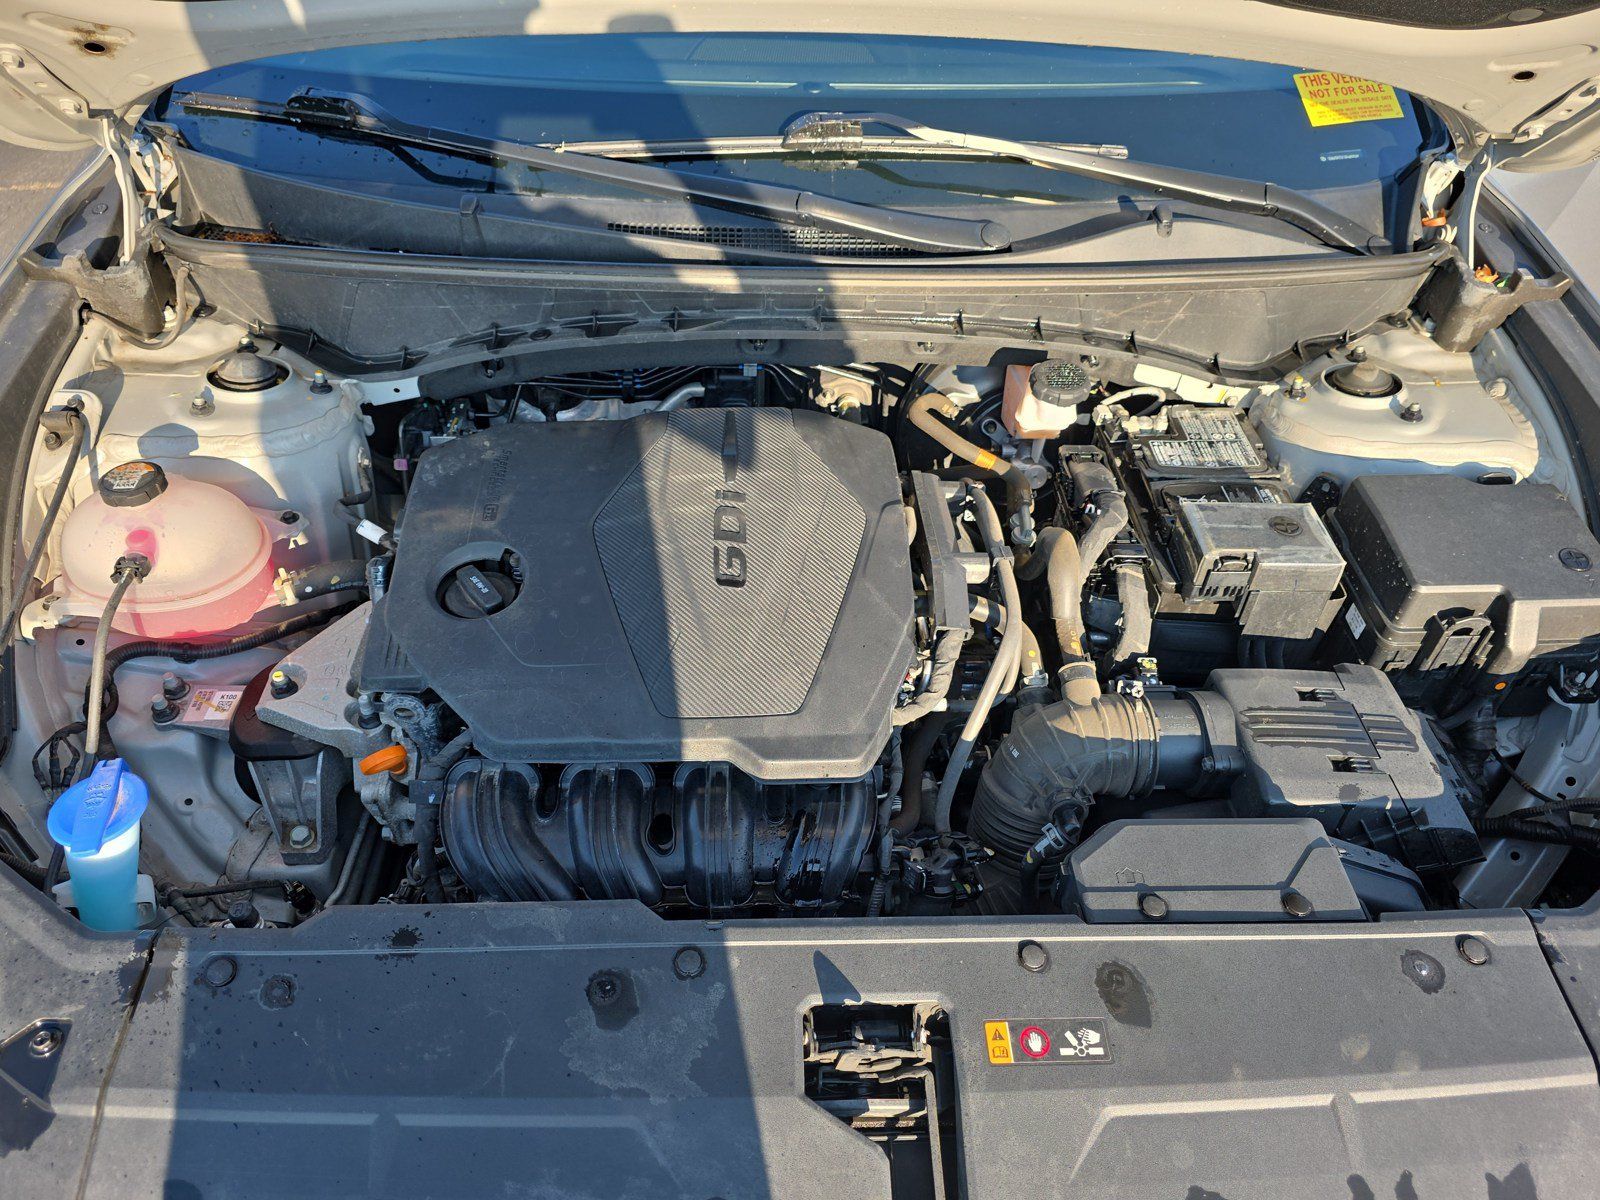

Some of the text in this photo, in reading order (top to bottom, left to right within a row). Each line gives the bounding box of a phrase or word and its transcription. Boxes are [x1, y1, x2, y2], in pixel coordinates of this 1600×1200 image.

[1300, 73, 1330, 87] THIS
[1309, 84, 1385, 99] NOT FOR SALE
